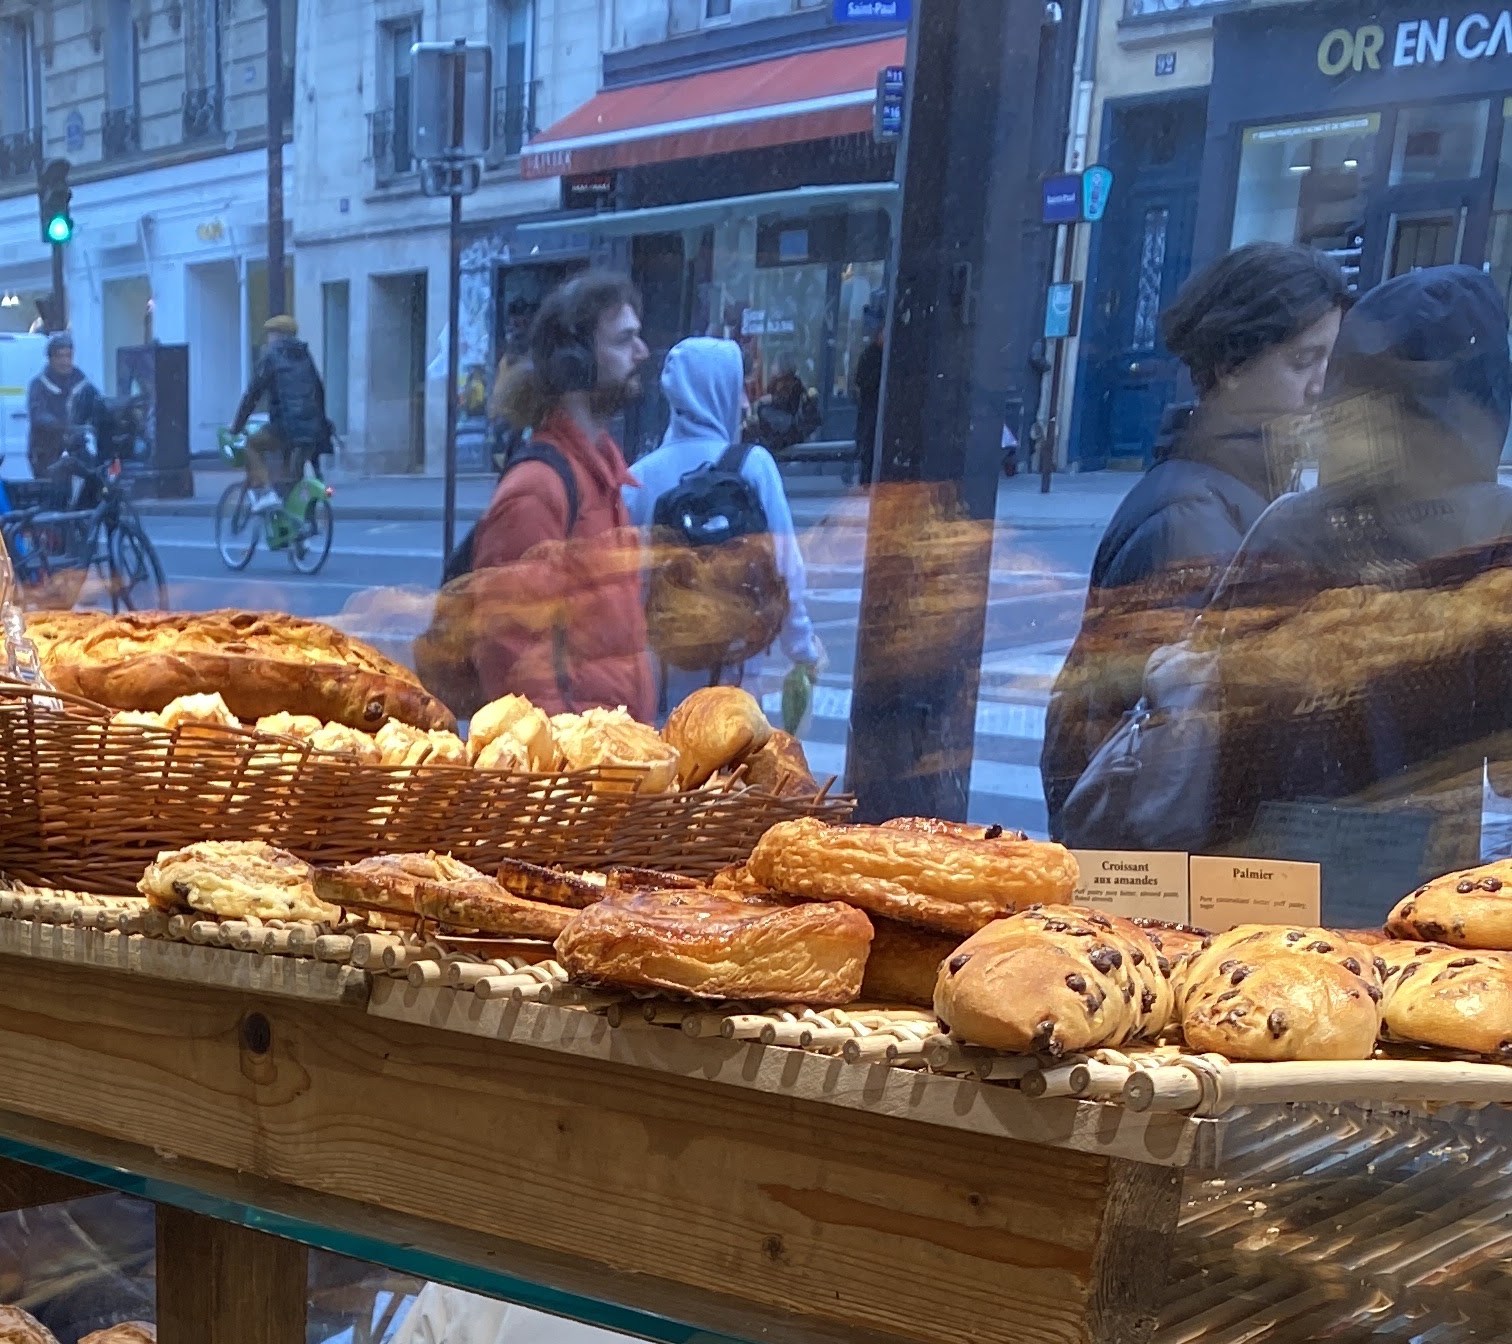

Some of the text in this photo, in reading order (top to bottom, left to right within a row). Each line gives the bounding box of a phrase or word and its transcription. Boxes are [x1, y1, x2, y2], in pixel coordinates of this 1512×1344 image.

[847, 1, 897, 16] Saint-Paul
[1317, 24, 1384, 75] OR
[1393, 17, 1449, 67] EN
[1102, 860, 1149, 872] Croissant
[1233, 868, 1273, 880] Palmier
[1094, 875, 1158, 886] aux amandes
